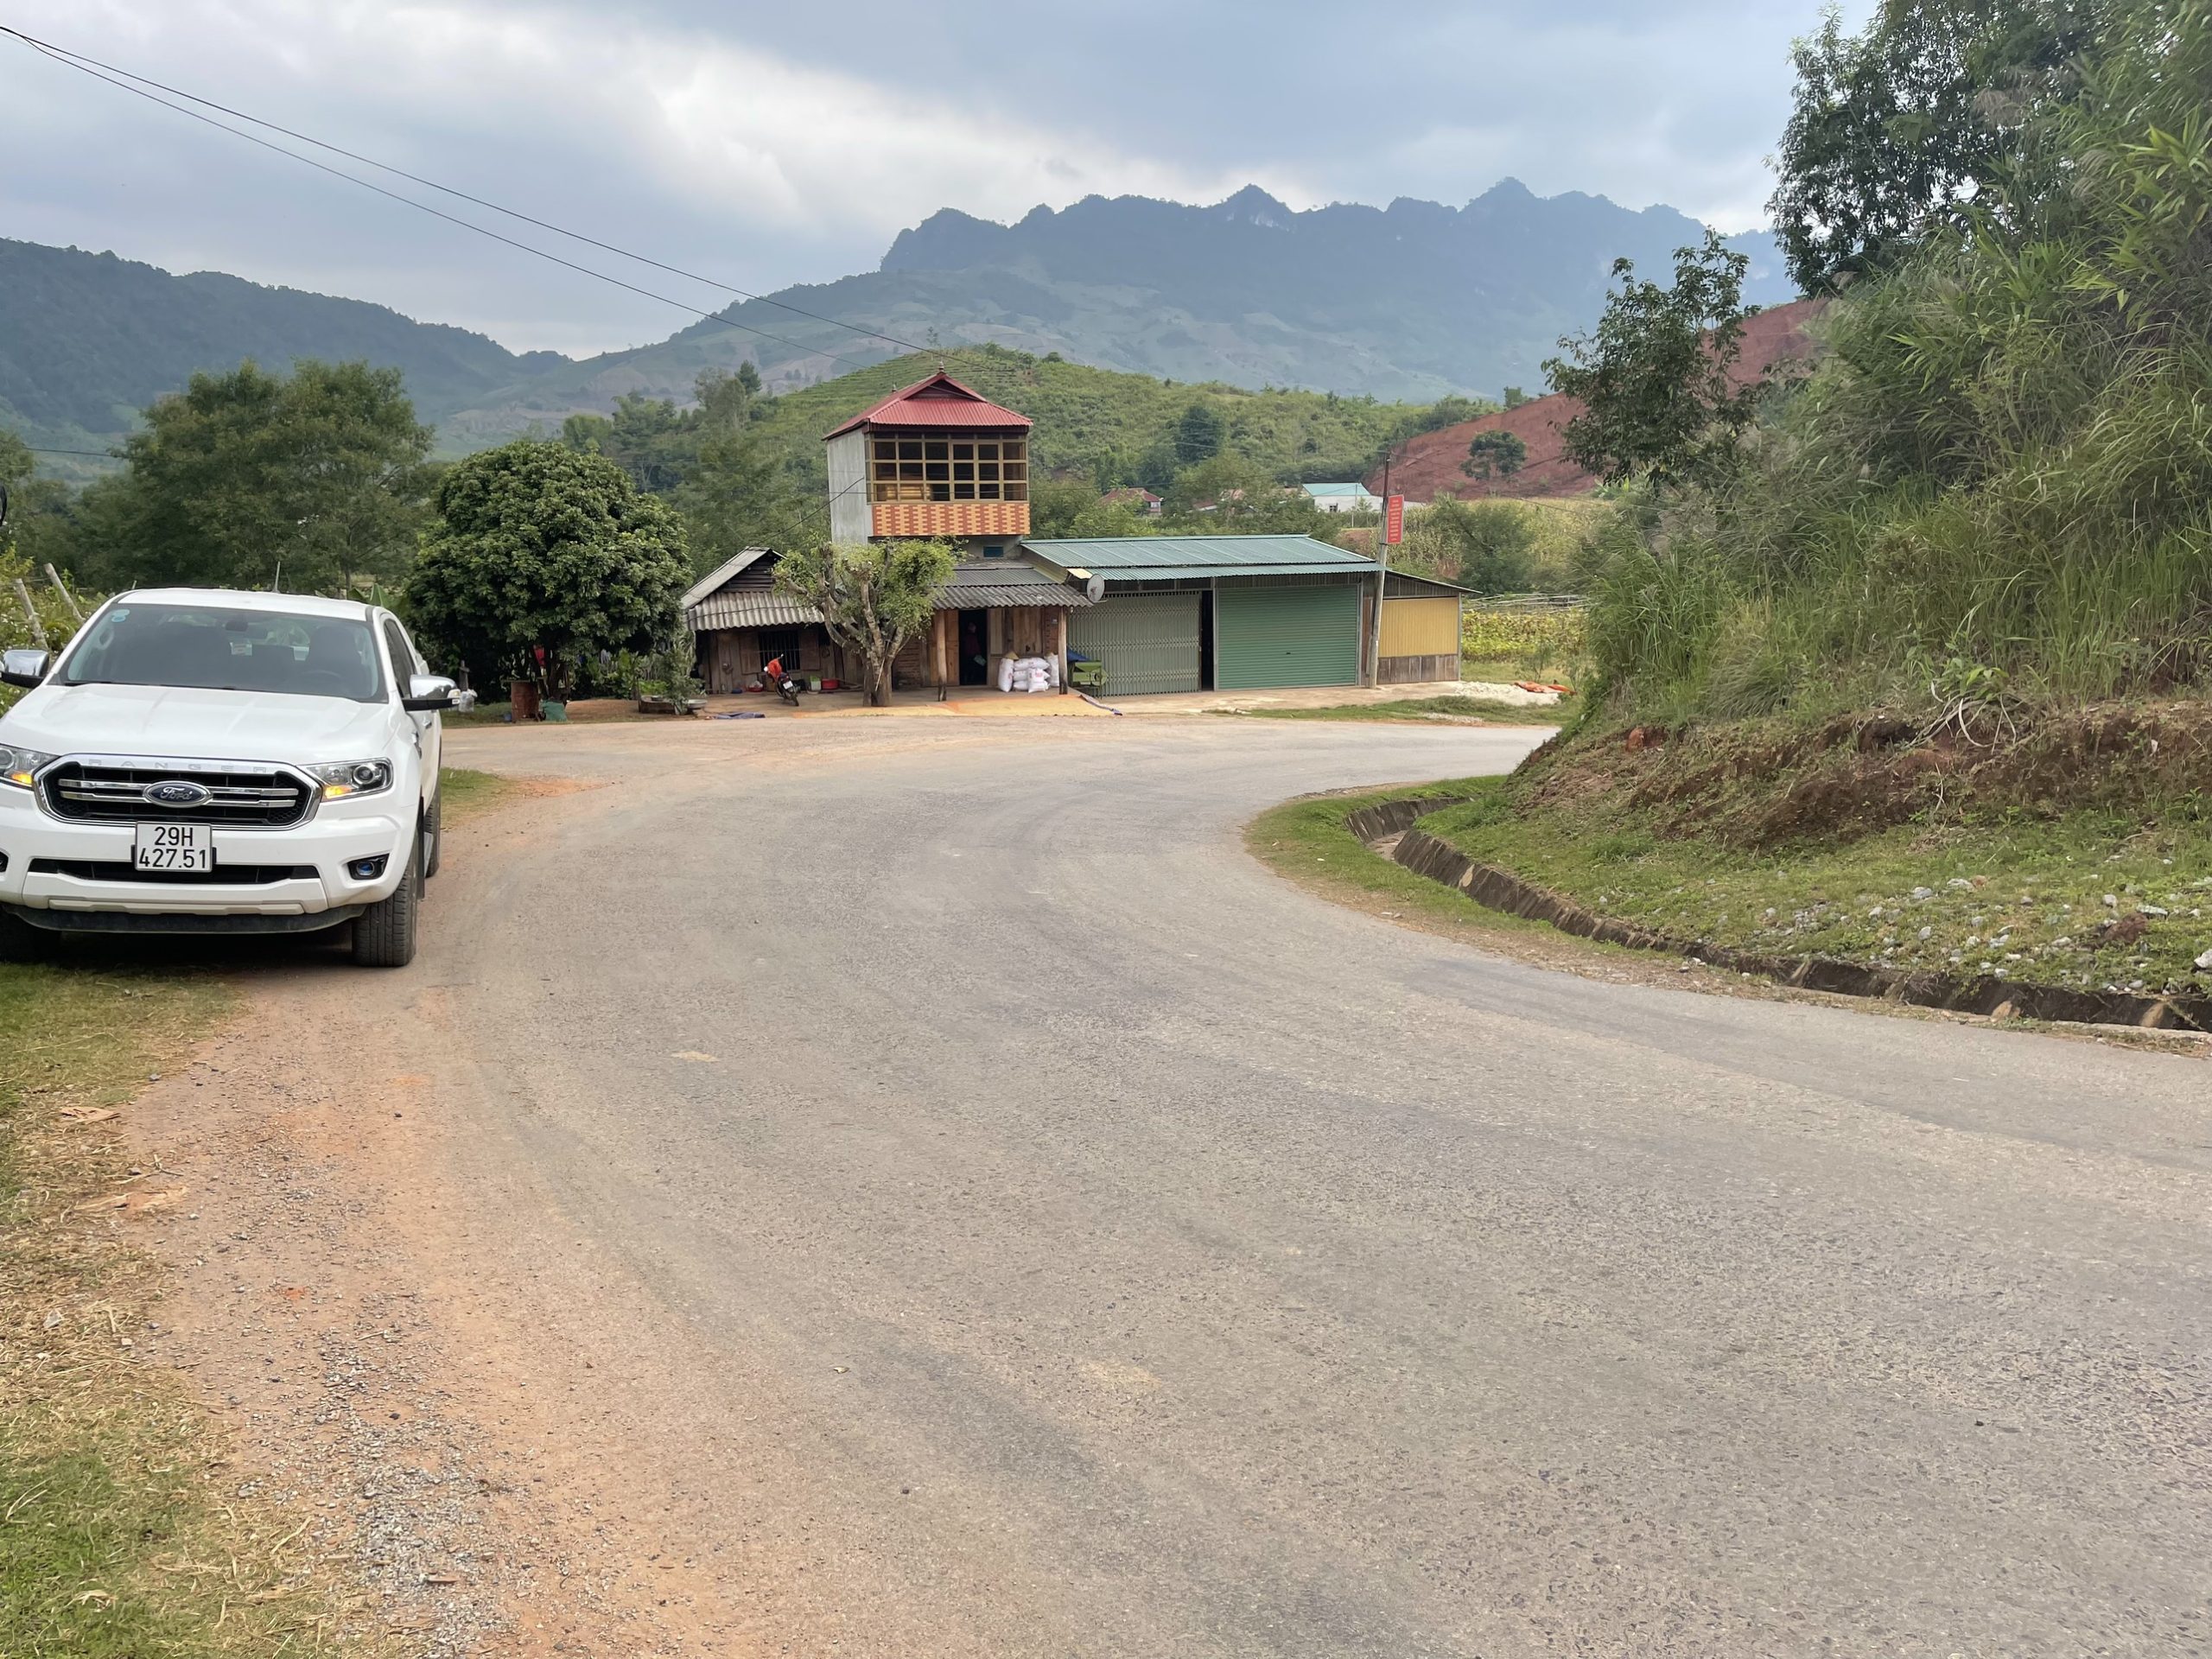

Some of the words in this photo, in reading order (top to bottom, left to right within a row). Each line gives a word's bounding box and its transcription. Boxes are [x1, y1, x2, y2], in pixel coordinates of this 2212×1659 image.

[88, 759, 267, 773] RANGER
[160, 786, 193, 801] Ford
[154, 826, 194, 847] 29H
[138, 848, 207, 869] 427.51
